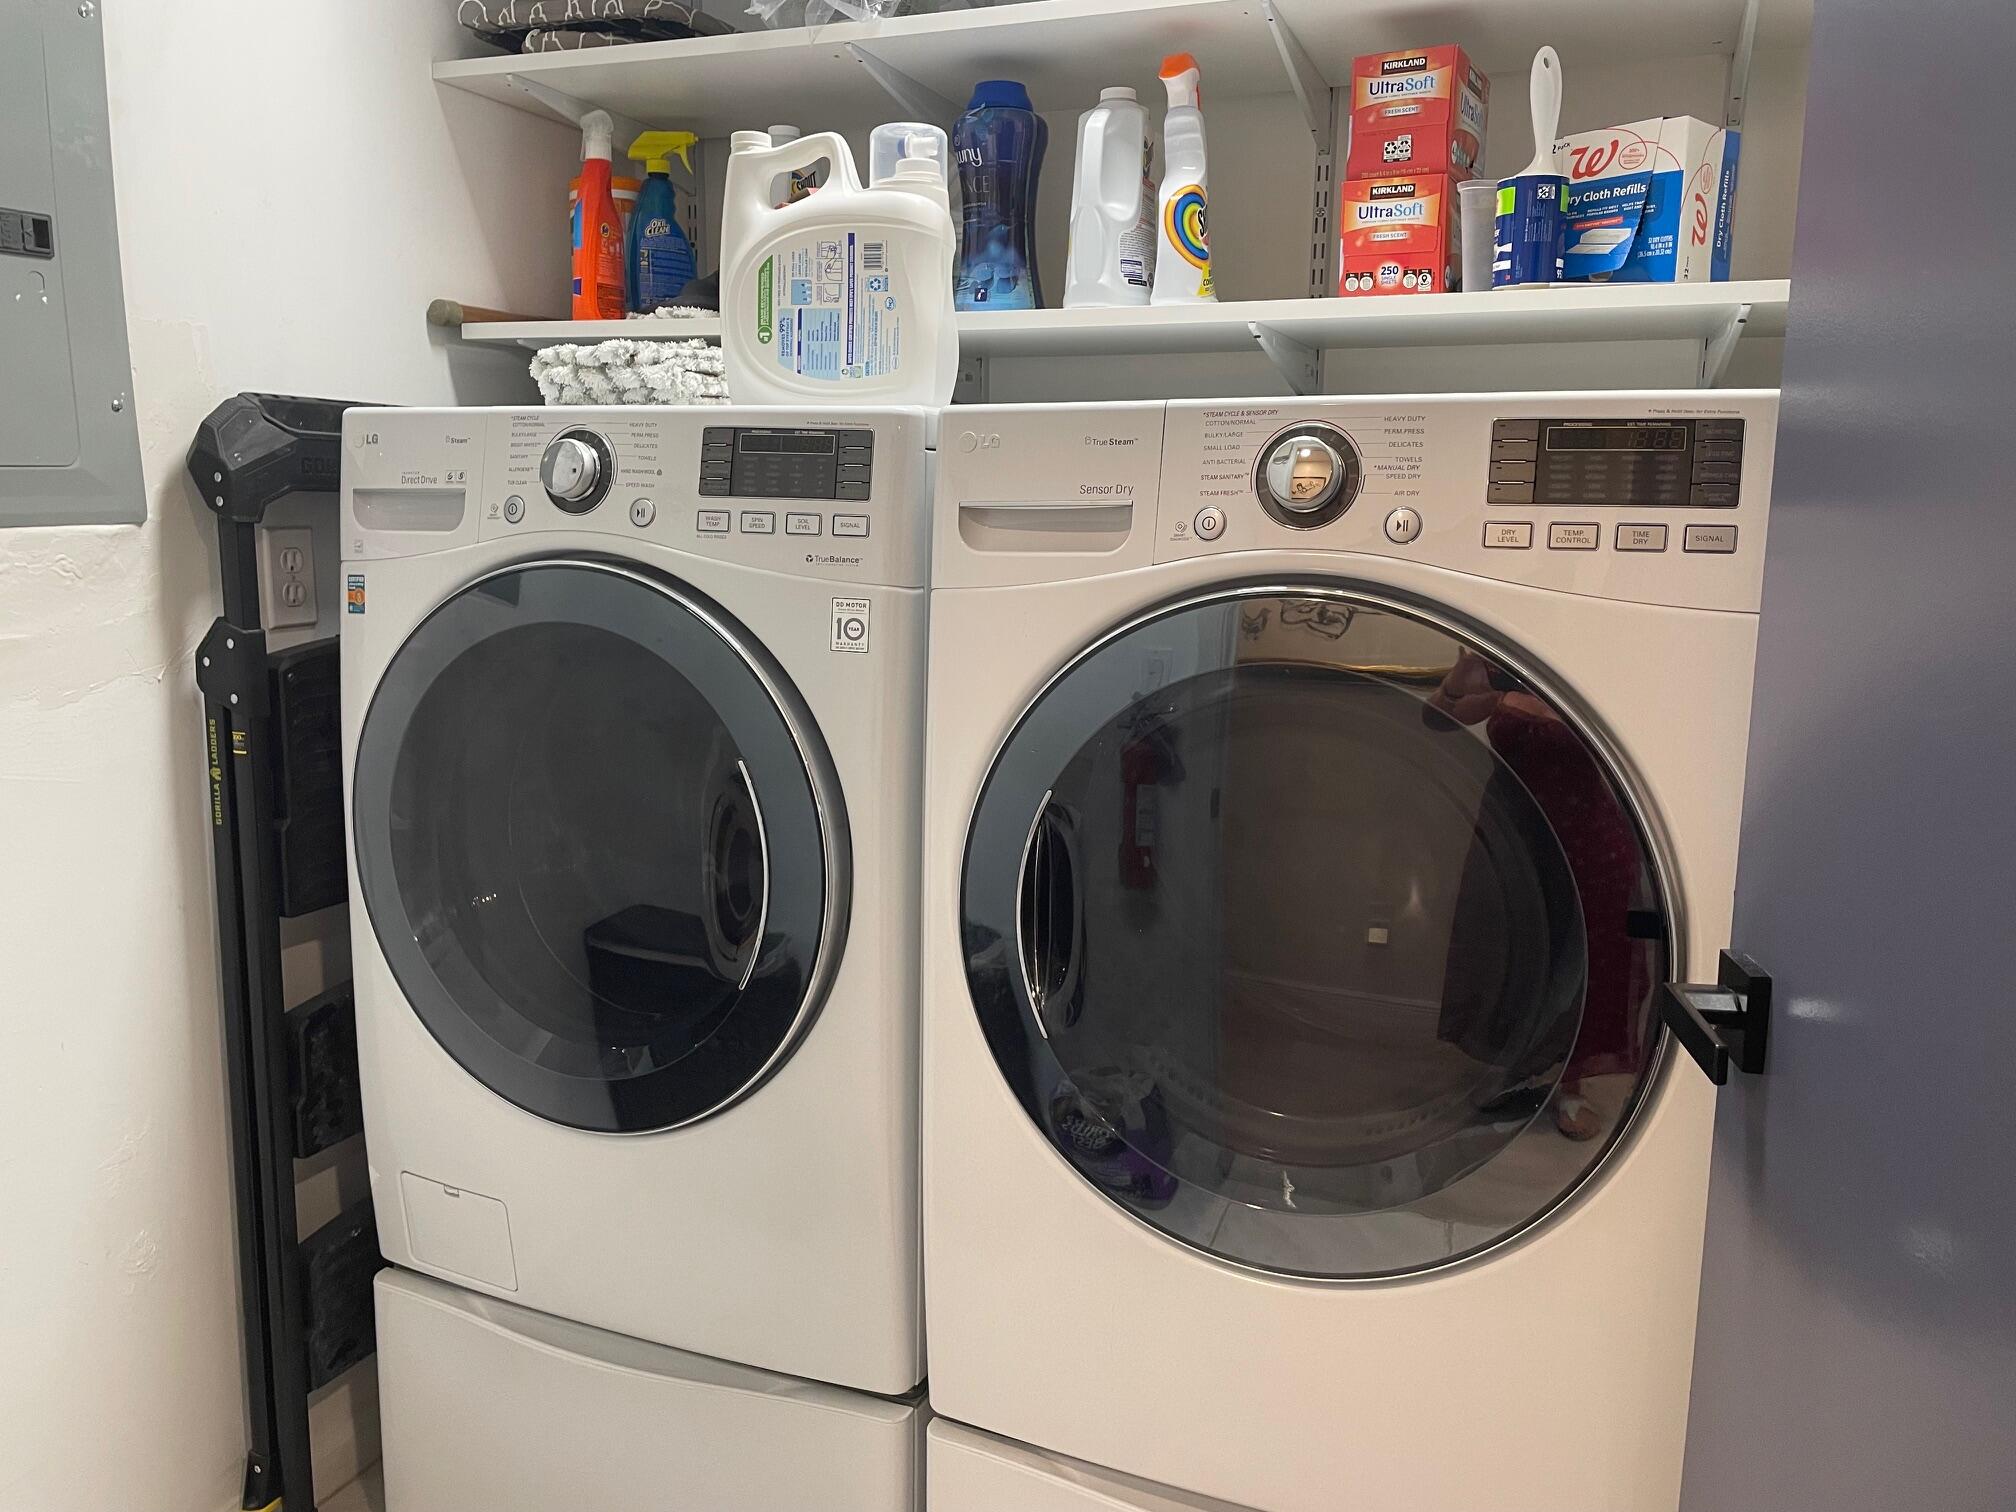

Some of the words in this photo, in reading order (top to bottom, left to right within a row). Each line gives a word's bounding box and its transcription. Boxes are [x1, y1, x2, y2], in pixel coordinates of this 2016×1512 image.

[1384, 57, 1426, 71] KIRKLAND
[1369, 75, 1436, 96] UltraSoft
[1384, 107, 1401, 115] FRESH
[1402, 105, 1419, 113] SCENT
[1372, 185, 1414, 195] KIRKLAND
[1722, 170, 1730, 201] Refills
[1567, 194, 1581, 206] ry
[1583, 188, 1611, 201] Cloth
[1613, 183, 1647, 197] Refills
[1358, 202, 1424, 219] UltraSoft
[646, 225, 669, 236] CLEAN
[1381, 265, 1399, 275] 250
[366, 434, 379, 444] LG
[981, 434, 1000, 449] LG
[1080, 484, 1113, 494] Sensor
[1116, 484, 1134, 496] Dry
[1695, 535, 1724, 543] SIGNAL
[836, 618, 865, 641] 10
[209, 719, 219, 765] LADDERS
[214, 783, 222, 825] GORILLA
